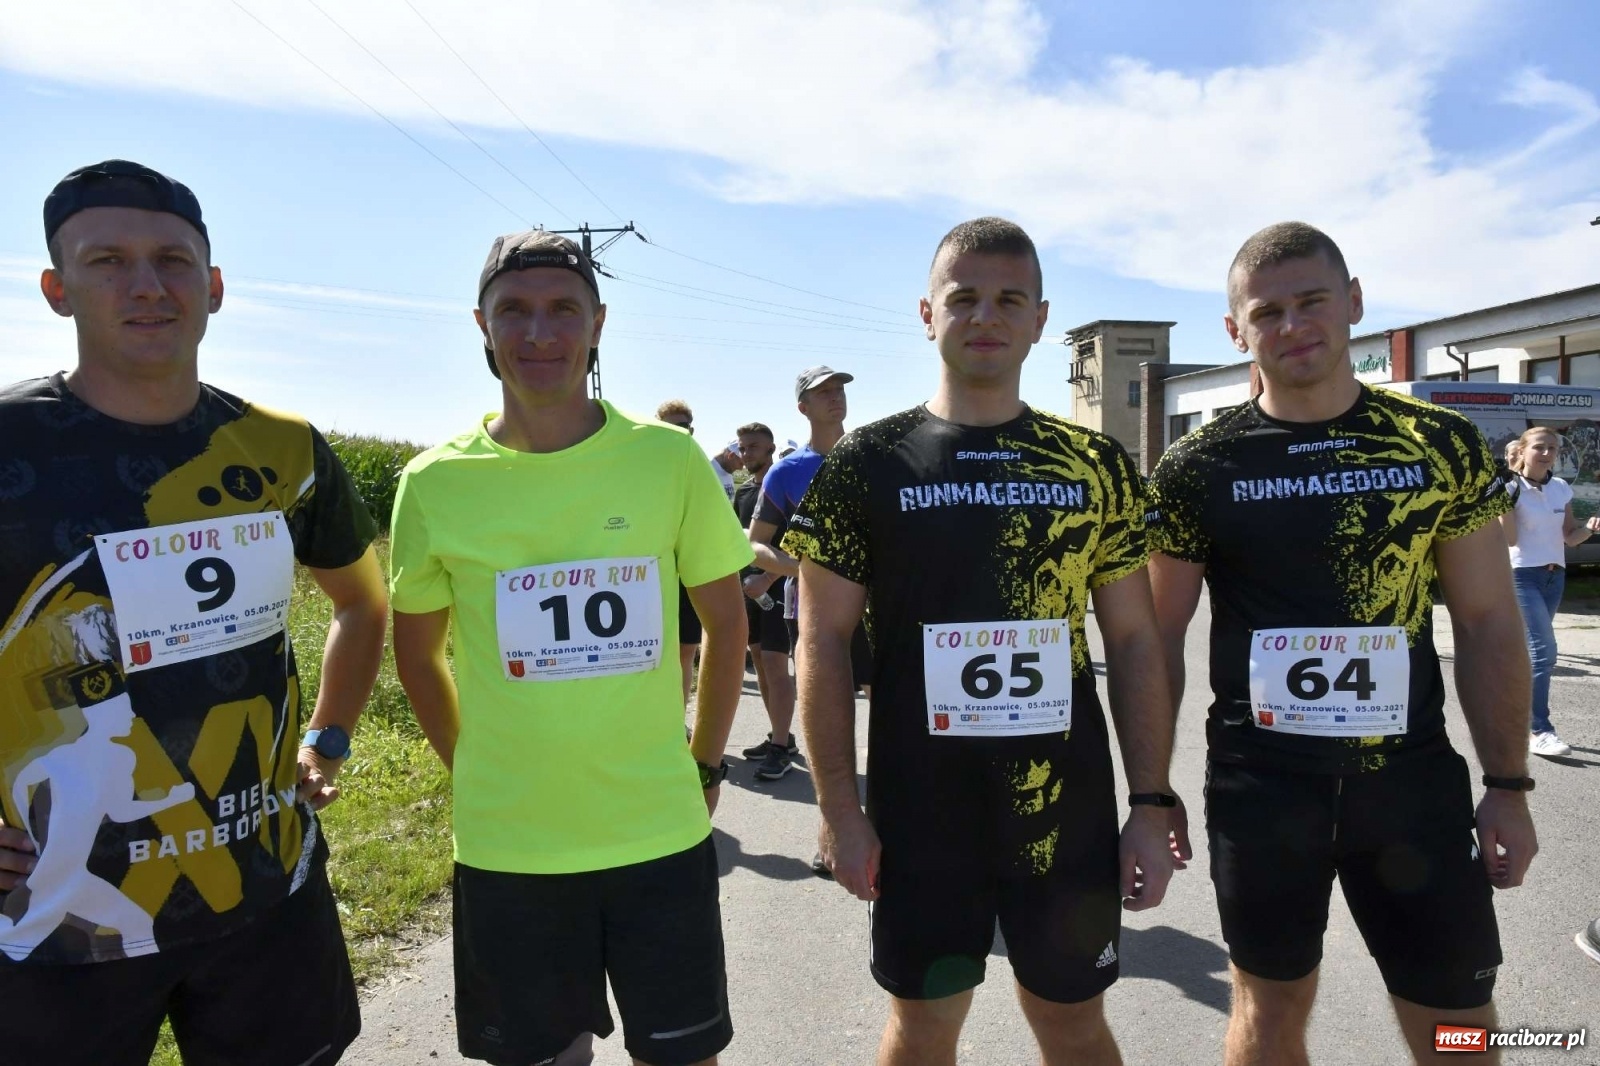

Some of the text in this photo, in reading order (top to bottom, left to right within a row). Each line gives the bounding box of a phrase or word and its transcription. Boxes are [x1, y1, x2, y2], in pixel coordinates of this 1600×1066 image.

[1513, 393, 1555, 405] POMIAR
[1556, 395, 1592, 407] CZASU
[956, 451, 1021, 461] SMMASH
[1287, 438, 1356, 454] SMMASH
[900, 482, 1083, 512] RUNMAGEDDON
[1232, 465, 1425, 502] RUNMAGEDDON
[115, 520, 276, 563] COLOUR RUN
[185, 557, 236, 613] 9
[508, 565, 647, 592] COLOUR RUN
[127, 627, 165, 642] 10km,
[170, 614, 239, 633] Krzanowice,
[539, 591, 627, 641] 10
[506, 650, 536, 659] 10km,
[541, 644, 602, 656] Krzanowice,
[607, 639, 659, 650] 05.09.2021
[935, 627, 1060, 648] COLOUR RUN
[1262, 635, 1397, 653] COLOUR RUN
[961, 652, 1044, 699] 65
[1286, 658, 1376, 701] 64
[932, 700, 1069, 712] 10km, Krzanowice, 05.09.2021
[1257, 703, 1404, 713] 10km, Krzanowice, 05.09.2021
